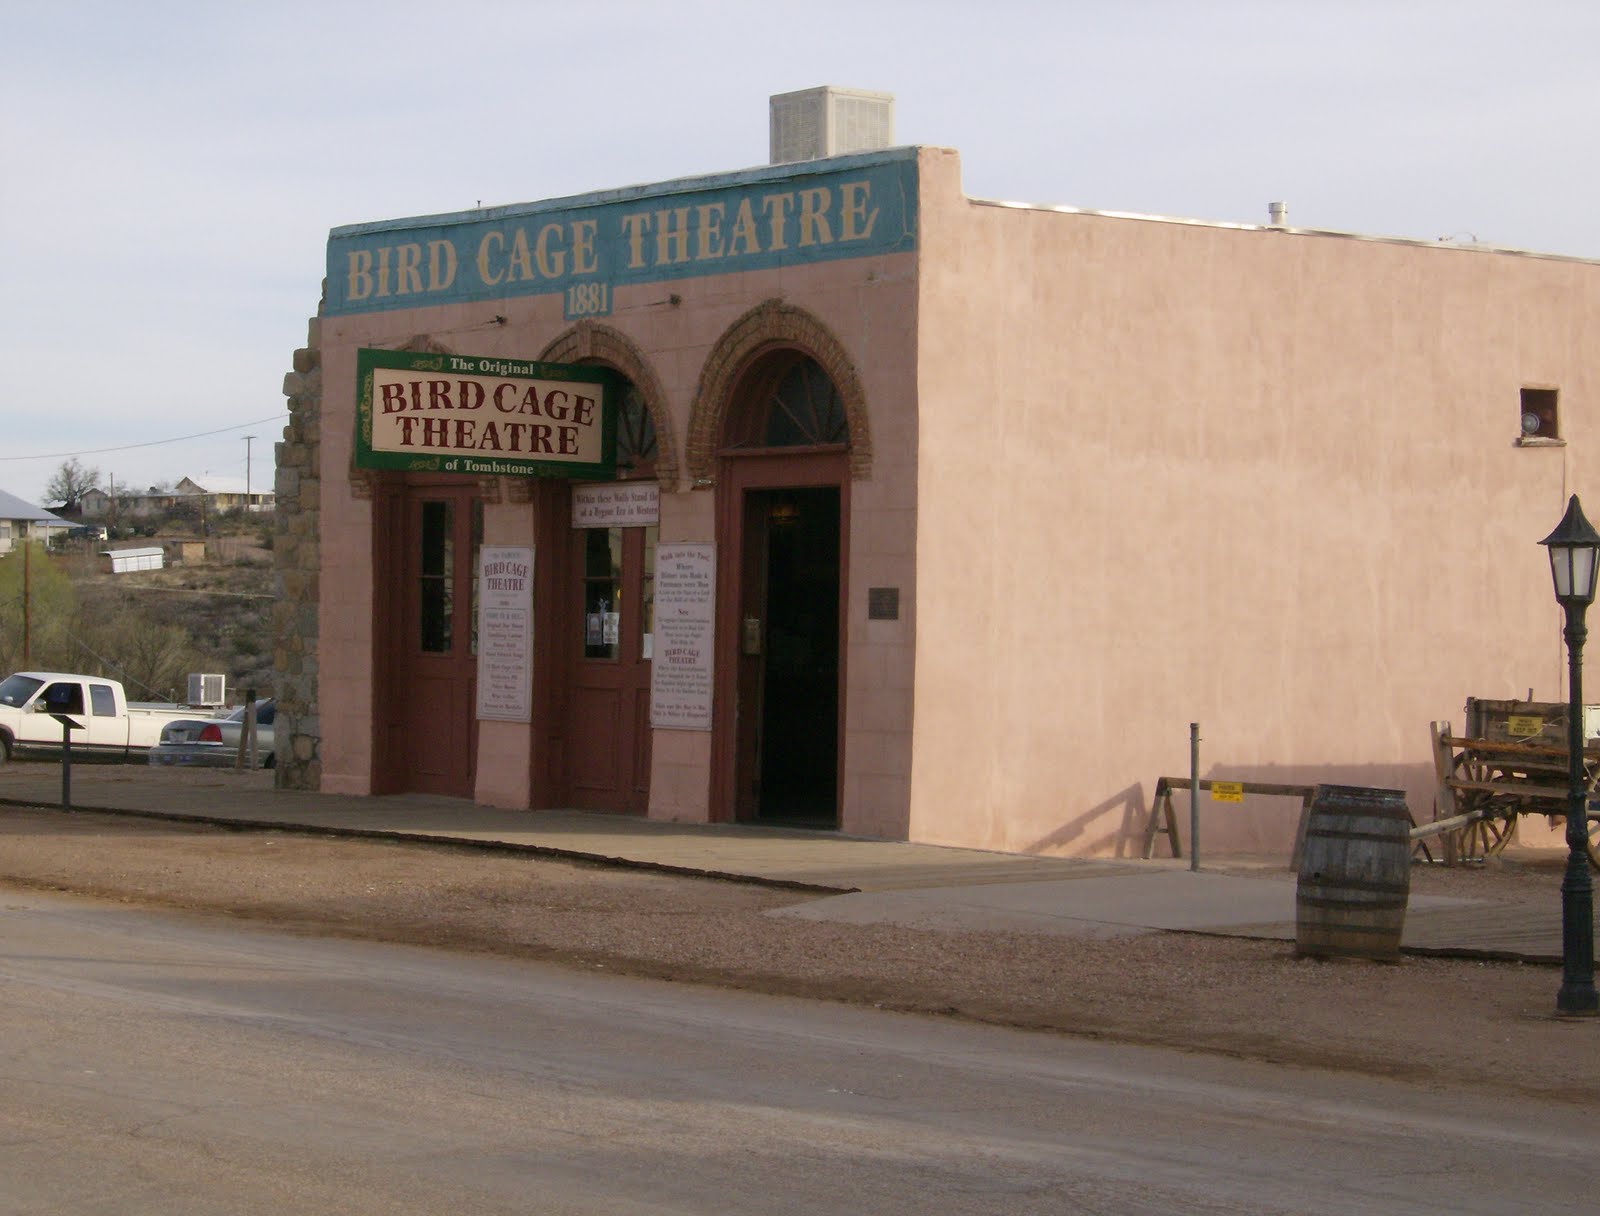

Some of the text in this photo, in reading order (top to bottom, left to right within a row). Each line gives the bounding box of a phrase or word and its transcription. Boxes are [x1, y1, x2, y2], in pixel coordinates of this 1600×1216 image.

[345, 180, 880, 301] BIRD CAGE THEATRE
[568, 282, 608, 315] 1881
[450, 357, 534, 376] The Original
[379, 380, 596, 426] BIRD CAGE
[396, 416, 580, 455] THEATRE
[445, 458, 534, 475] of Tombstone
[484, 561, 528, 578] BIRD CAGE
[487, 578, 524, 590] THEATRE
